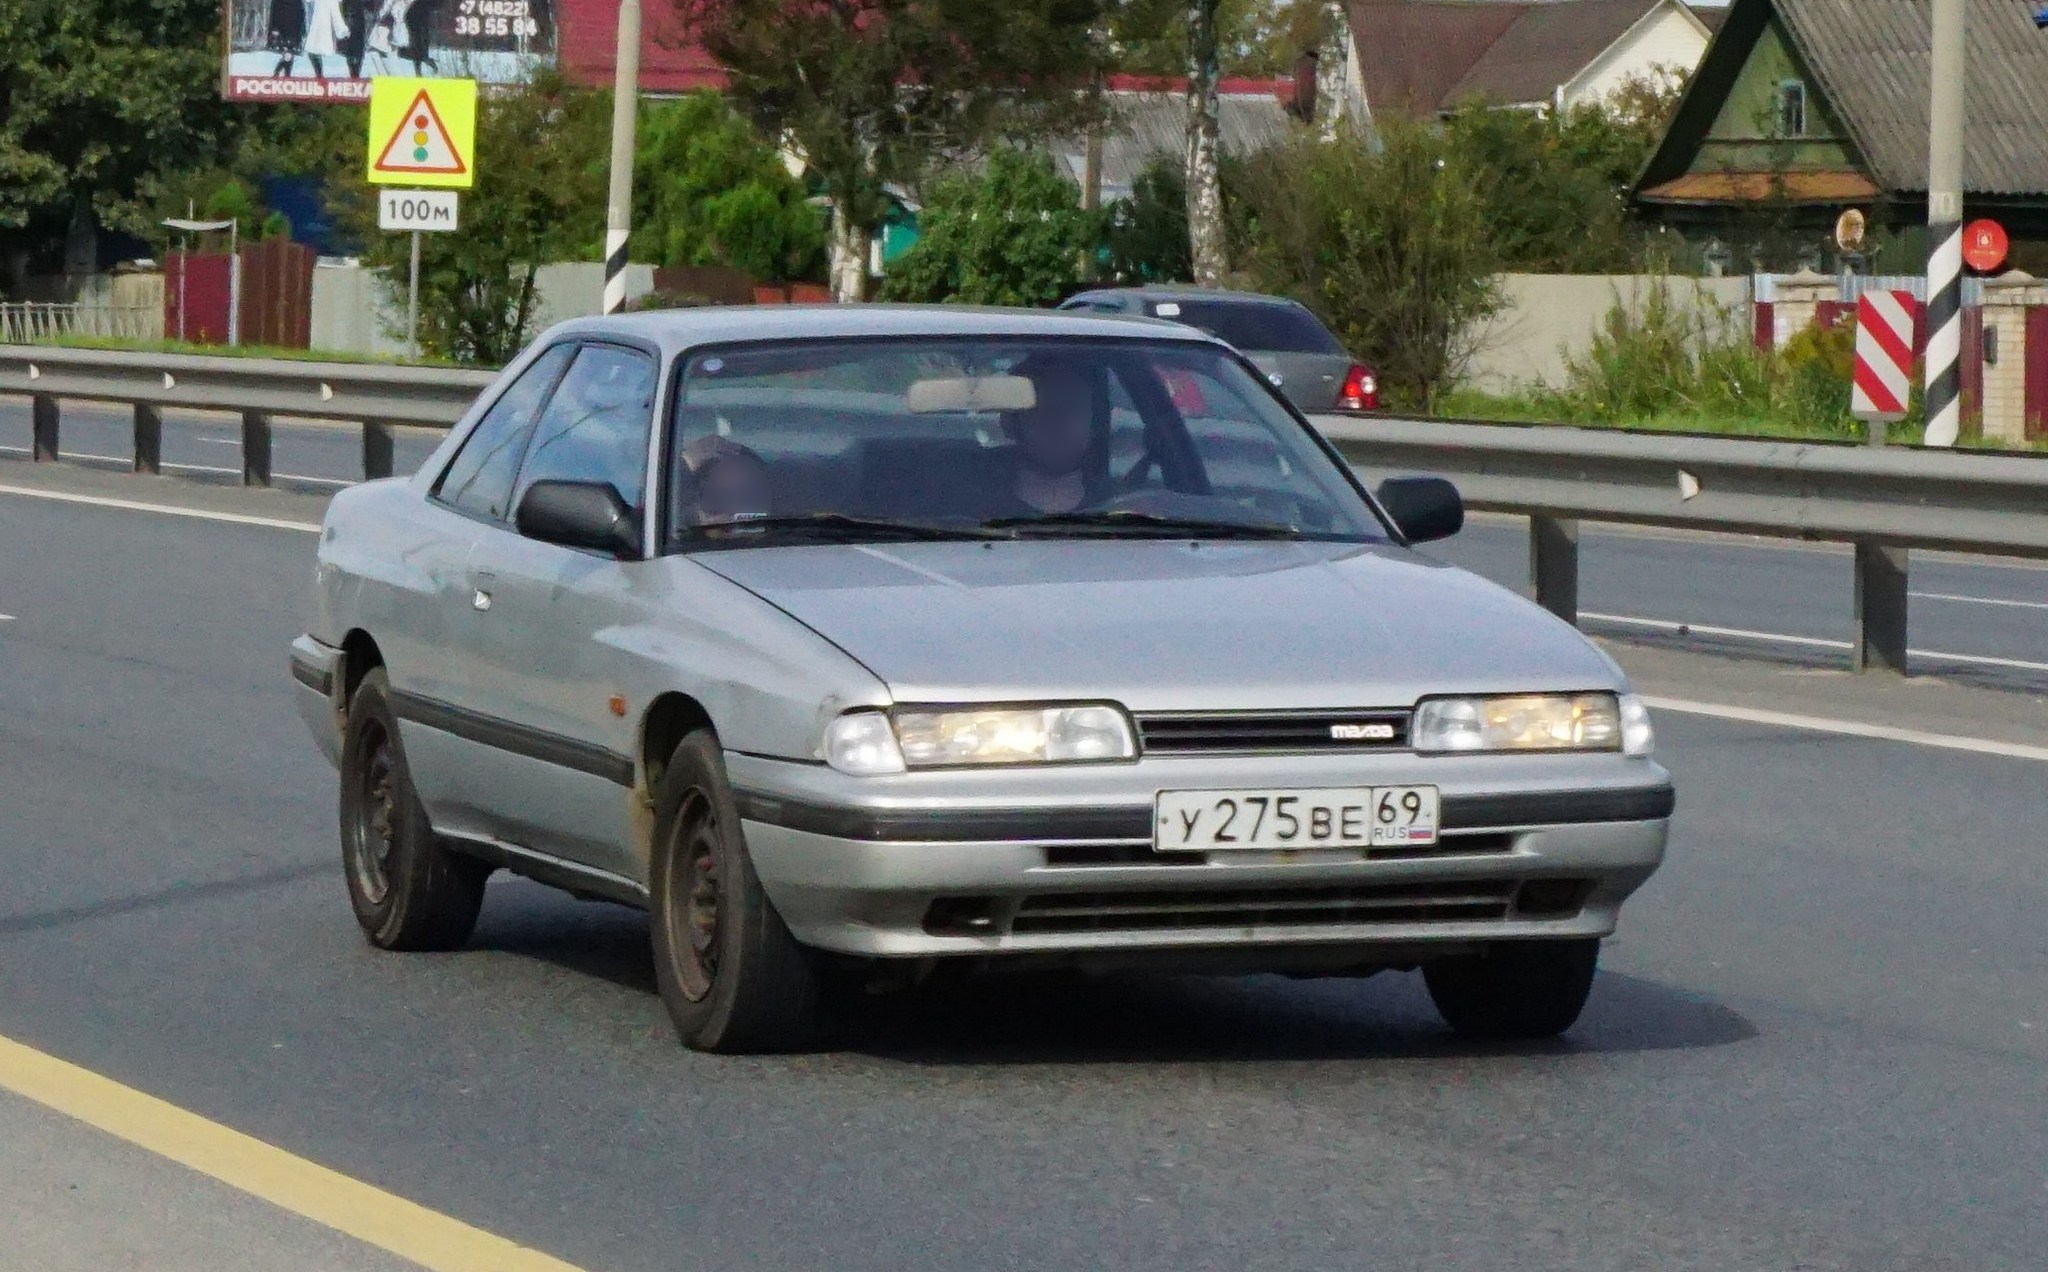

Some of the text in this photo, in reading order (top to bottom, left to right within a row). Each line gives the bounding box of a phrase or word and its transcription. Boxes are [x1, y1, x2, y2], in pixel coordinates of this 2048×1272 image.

[455, 16, 537, 37] 38 55 84
[236, 79, 325, 96] РОСКОШЬ
[1378, 791, 1421, 825] 69
[1374, 826, 1407, 839] RUS
